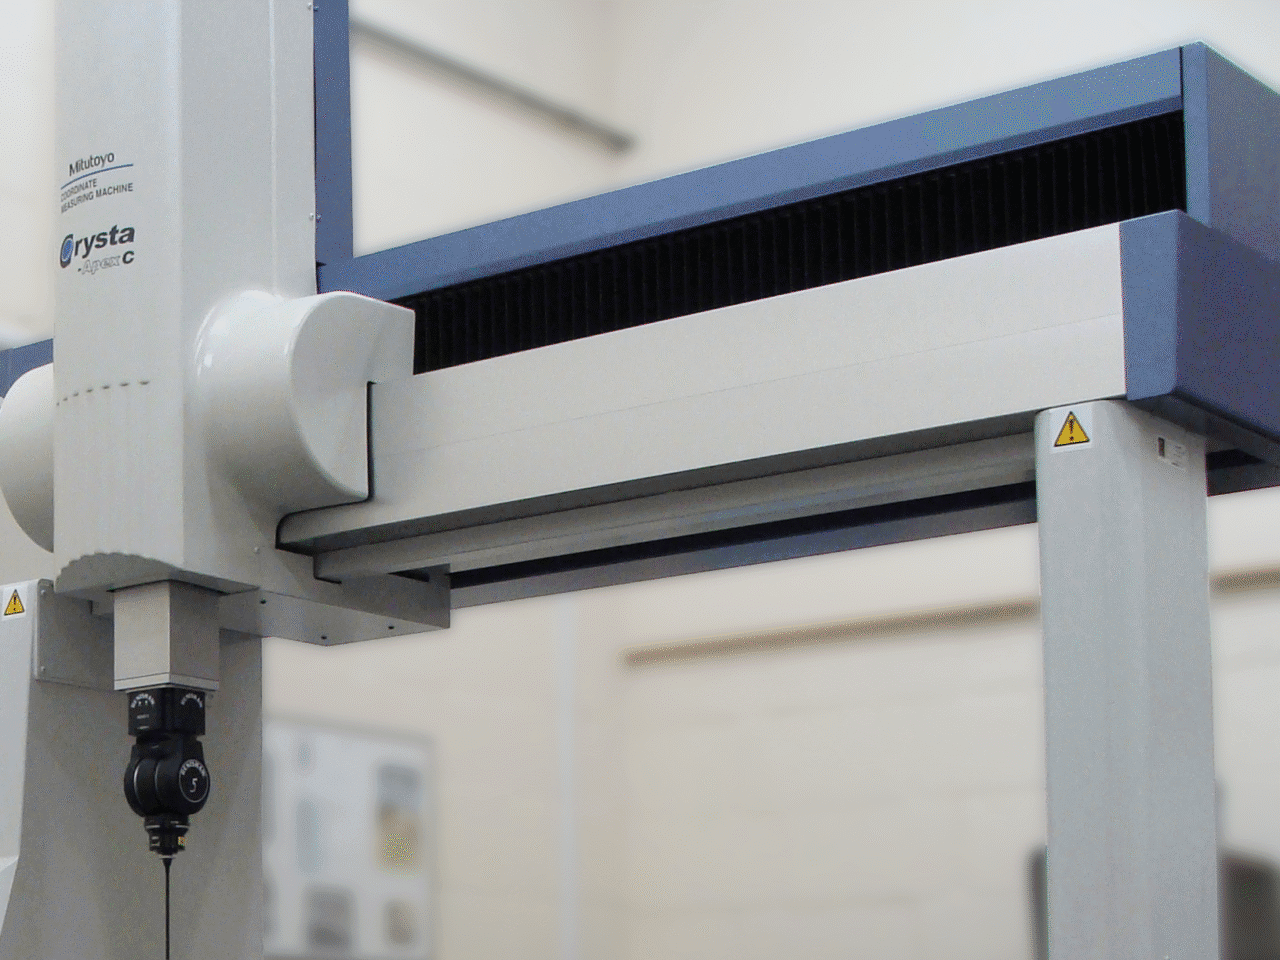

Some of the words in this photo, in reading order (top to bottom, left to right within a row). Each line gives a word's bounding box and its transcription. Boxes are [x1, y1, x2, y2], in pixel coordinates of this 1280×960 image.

[69, 152, 115, 177] Mitutoyo
[95, 182, 134, 198] MACHINE
[189, 777, 199, 793] 5
